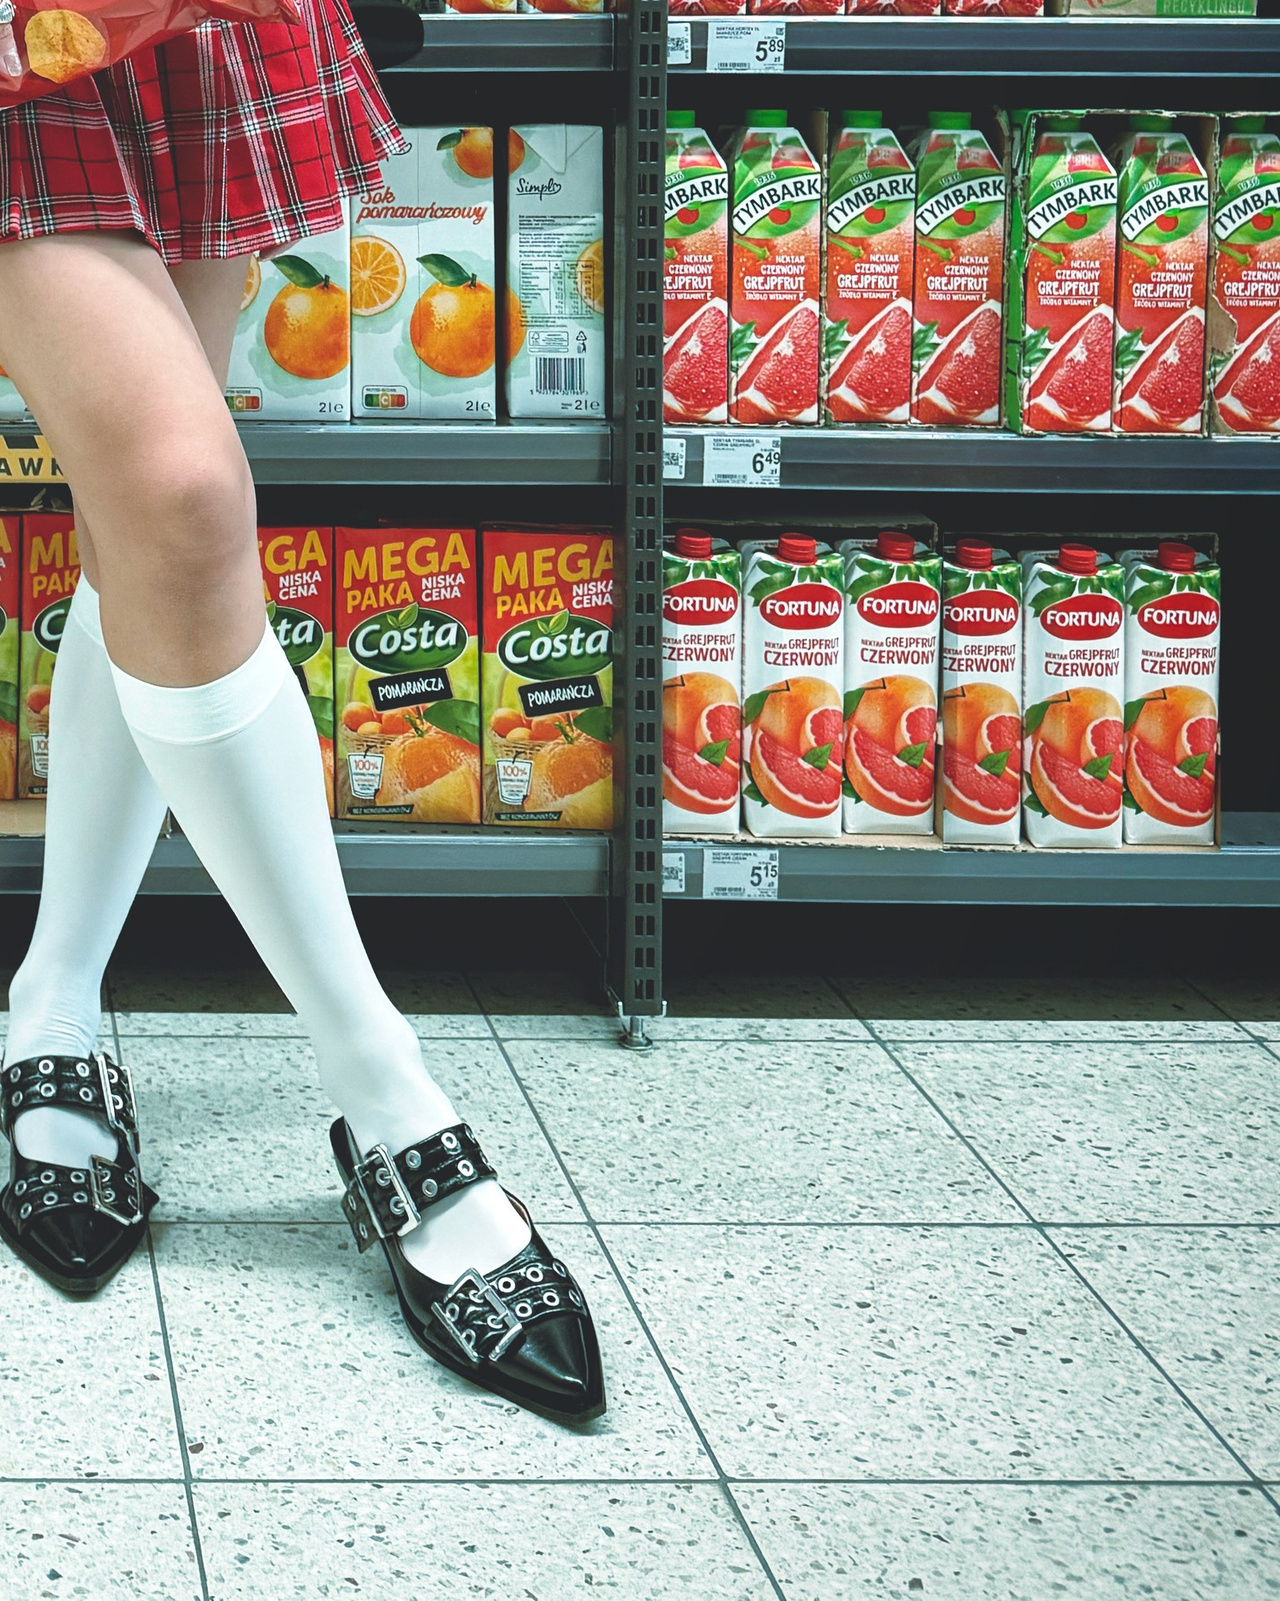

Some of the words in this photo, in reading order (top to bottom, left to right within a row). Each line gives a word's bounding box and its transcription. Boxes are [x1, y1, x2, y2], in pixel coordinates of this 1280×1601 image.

[734, 178, 820, 226] TYMBARK
[1028, 183, 1116, 232] TYMBARK
[760, 264, 806, 275] CZERWONY
[744, 274, 805, 291] GREJPFRUT
[1037, 279, 1100, 296] GREJPFRUT
[19, 456, 43, 477] W
[342, 532, 471, 589] MEGA
[766, 599, 840, 617] FORTUNA
[1143, 607, 1218, 625] FORTUNA
[1046, 610, 1120, 627] FORTUNA
[355, 617, 459, 658] Costa
[788, 637, 839, 650] GREJPFRUT
[764, 650, 839, 666] CZERWONY
[1044, 661, 1119, 677] CZERWONY
[378, 677, 445, 701] POMARAŃCZA
